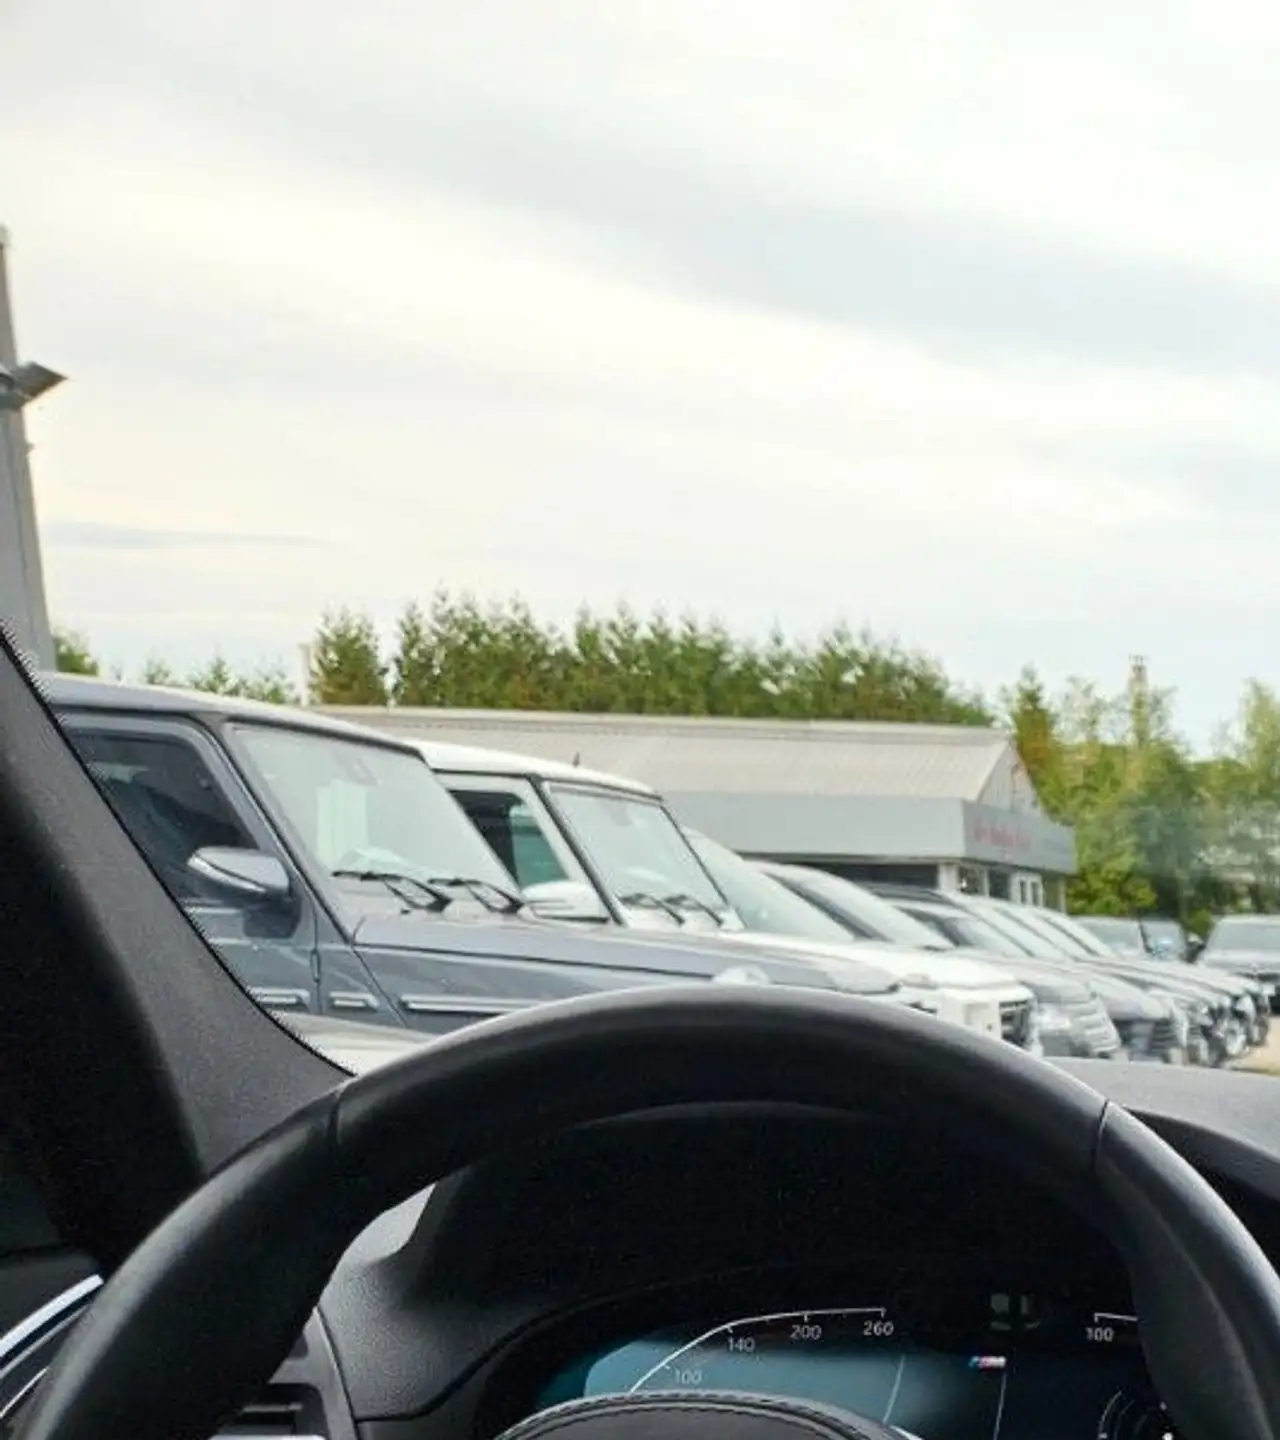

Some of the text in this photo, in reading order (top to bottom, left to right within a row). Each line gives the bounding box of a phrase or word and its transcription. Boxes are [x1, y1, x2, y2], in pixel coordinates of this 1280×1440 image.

[790, 1324, 822, 1341] 200
[863, 1320, 894, 1336] 260
[1086, 1326, 1114, 1342] 100
[727, 1336, 756, 1353] 140
[674, 1370, 702, 1385] 100
